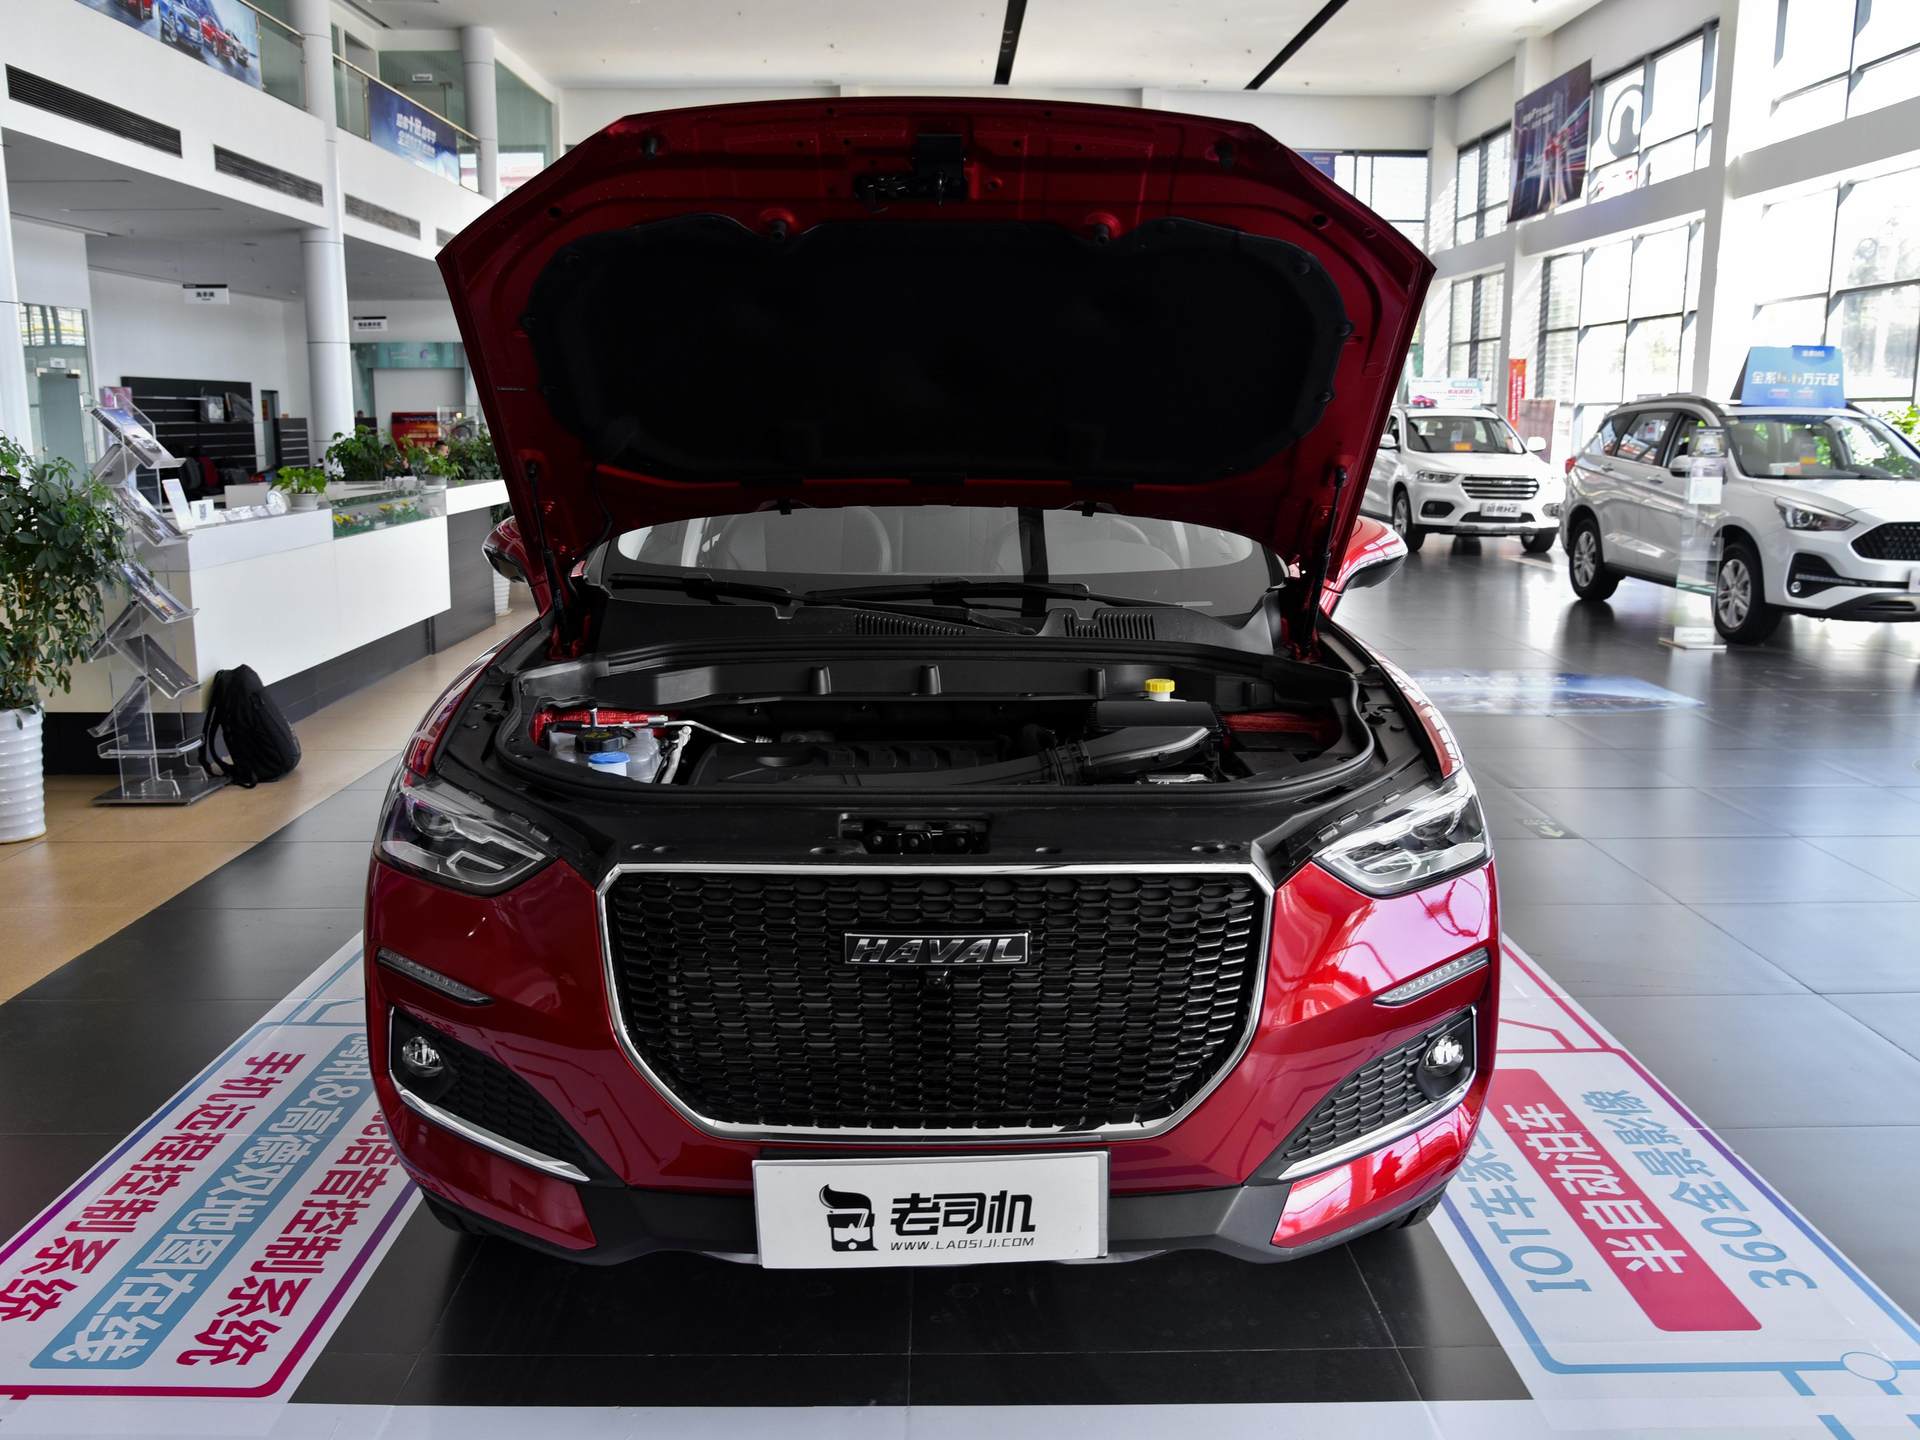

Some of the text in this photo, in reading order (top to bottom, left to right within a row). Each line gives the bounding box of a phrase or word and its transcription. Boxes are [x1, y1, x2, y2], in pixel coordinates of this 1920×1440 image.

[850, 938, 1023, 963] HAVAL
[0, 1051, 305, 1322] 手机远程控制系统
[890, 1190, 1036, 1237] 老司机
[1506, 1103, 1687, 1275] 半自动泊车
[1581, 1089, 1818, 1292] 360全景影像
[890, 1237, 1035, 1252] WWW.LAOSIJI.COM
